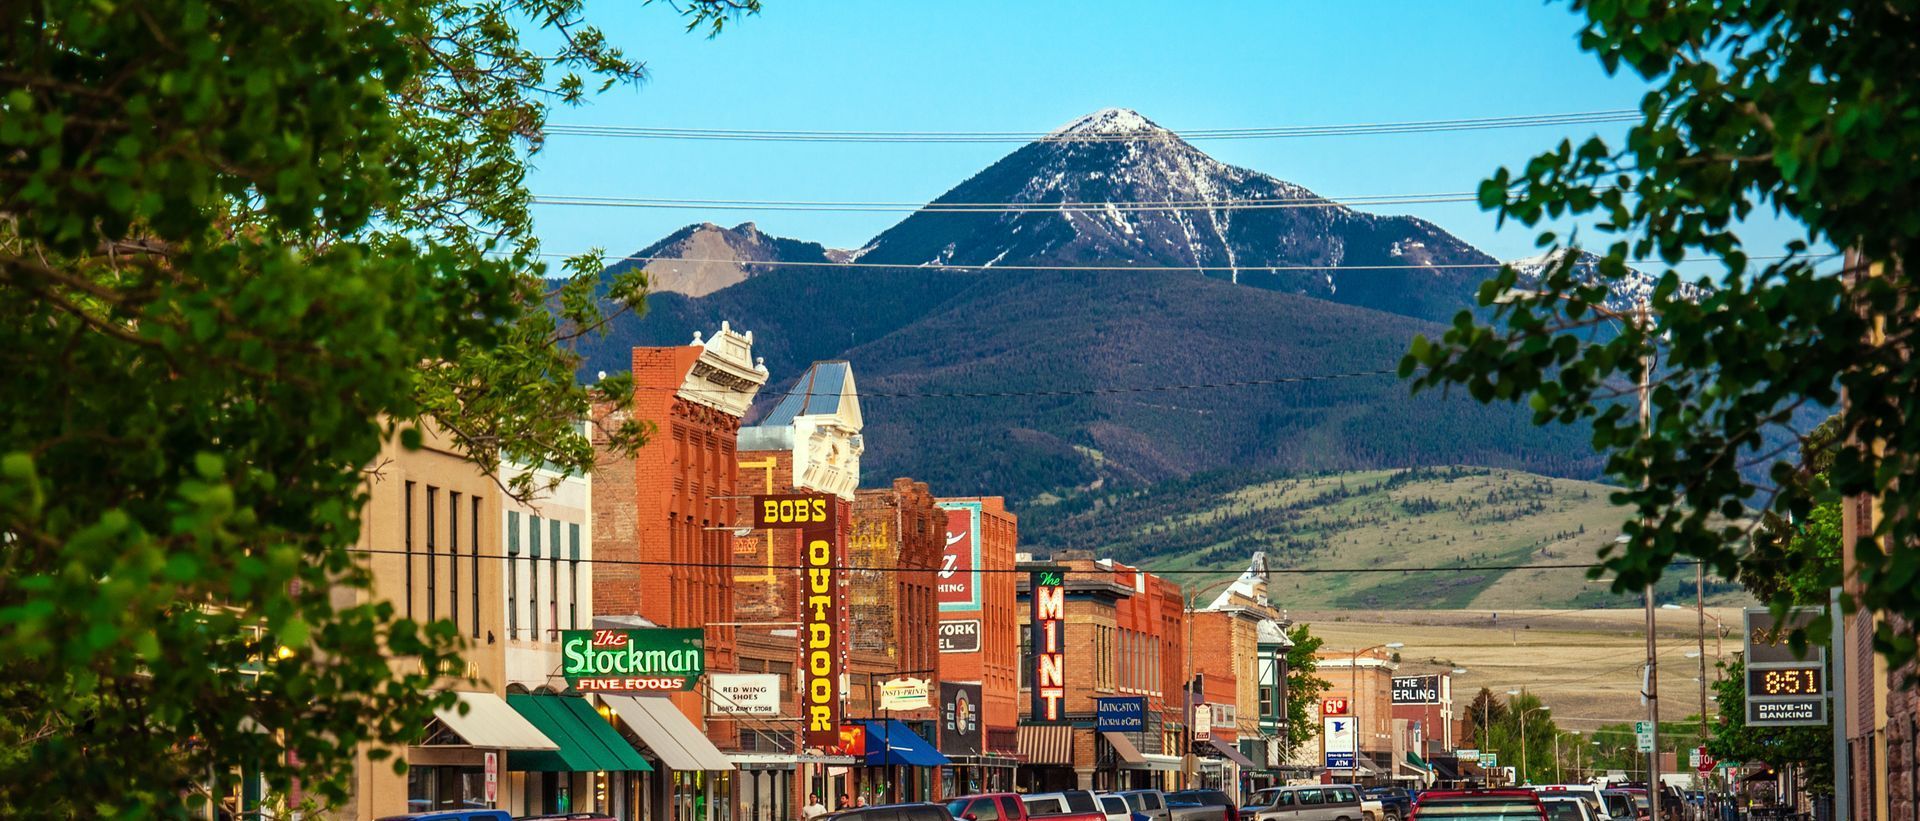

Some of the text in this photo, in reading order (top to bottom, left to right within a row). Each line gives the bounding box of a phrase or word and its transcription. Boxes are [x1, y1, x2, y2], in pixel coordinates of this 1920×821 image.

[764, 497, 826, 523] BOB'S
[1040, 571, 1060, 586] The
[808, 540, 832, 732] OUTDOOR
[939, 624, 975, 636] YORK
[593, 630, 628, 646] The
[564, 638, 701, 674] Stockman
[1037, 586, 1064, 721] MINT
[576, 678, 685, 690] FINE FOODS
[1394, 679, 1418, 687] THE
[1765, 670, 1817, 694] 8:51
[1391, 690, 1436, 700] ERLING
[1759, 704, 1813, 712] DRIVE-IN
[1759, 711, 1813, 719] BANKING
